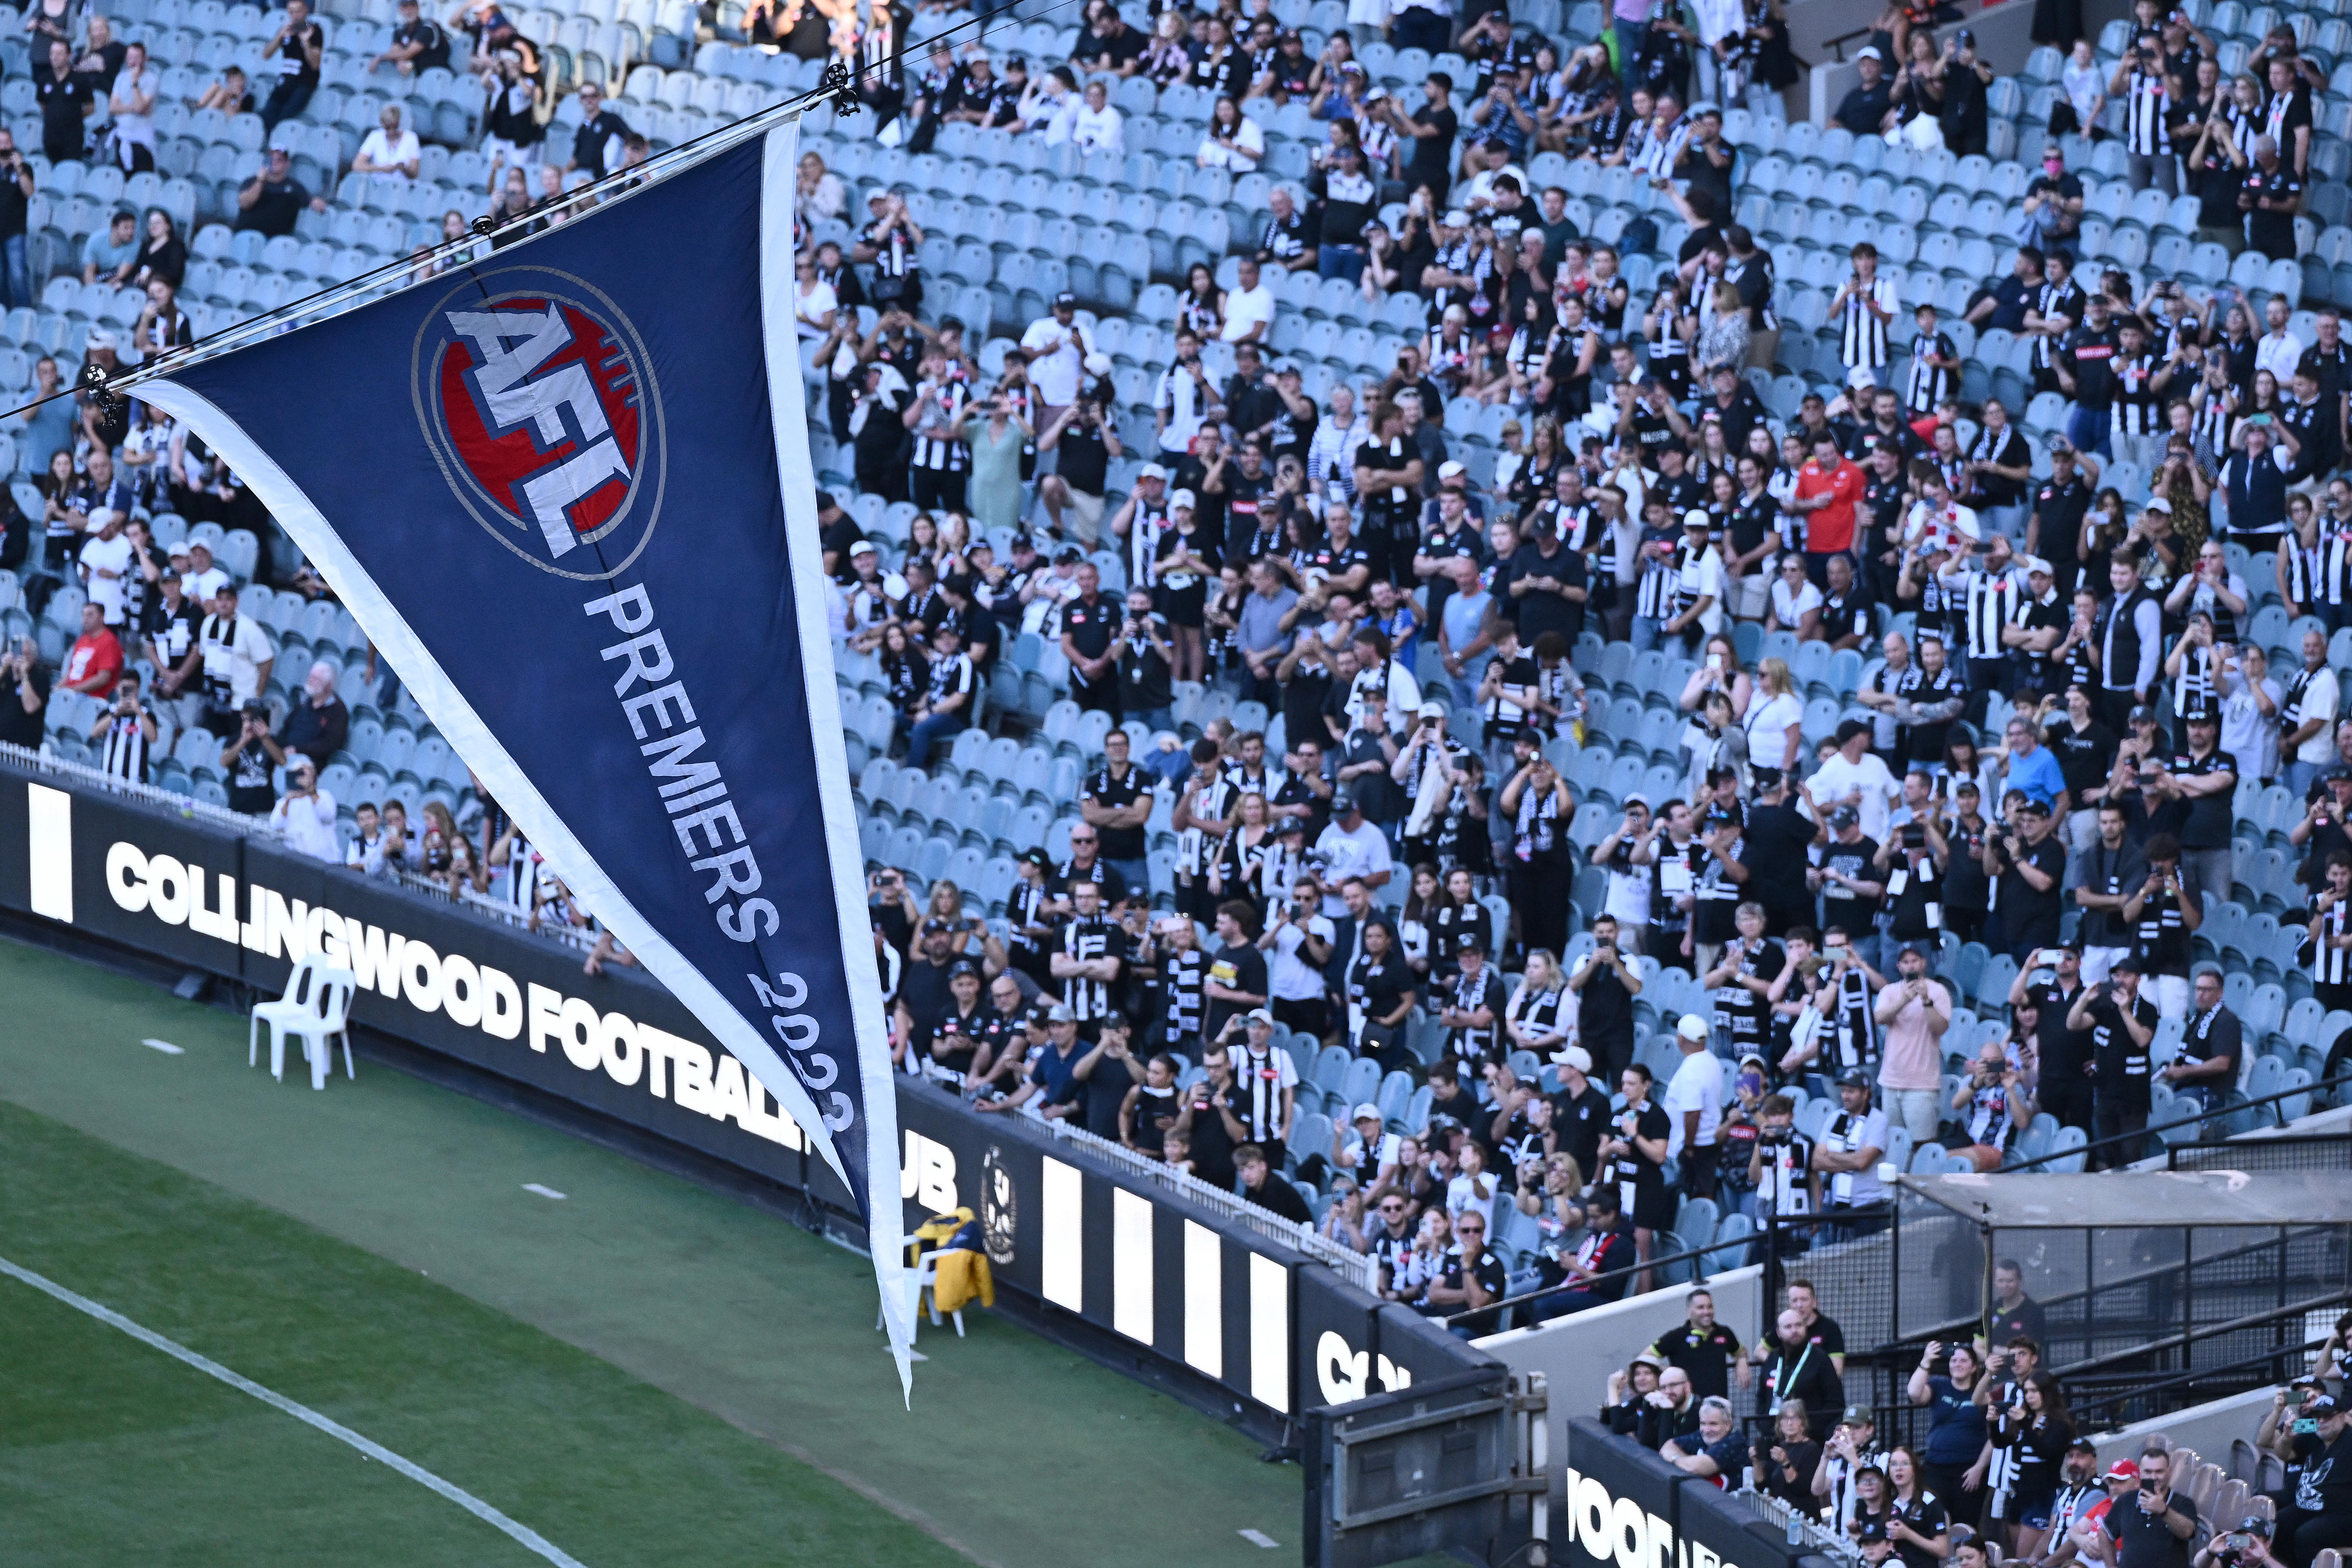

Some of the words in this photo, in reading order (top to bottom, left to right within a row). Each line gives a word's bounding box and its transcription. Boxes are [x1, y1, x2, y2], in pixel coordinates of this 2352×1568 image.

[444, 301, 631, 559] AFL
[106, 842, 523, 1040] COLLINGWOOD
[583, 582, 780, 942] PREMIERS
[747, 972, 854, 1138] 2023
